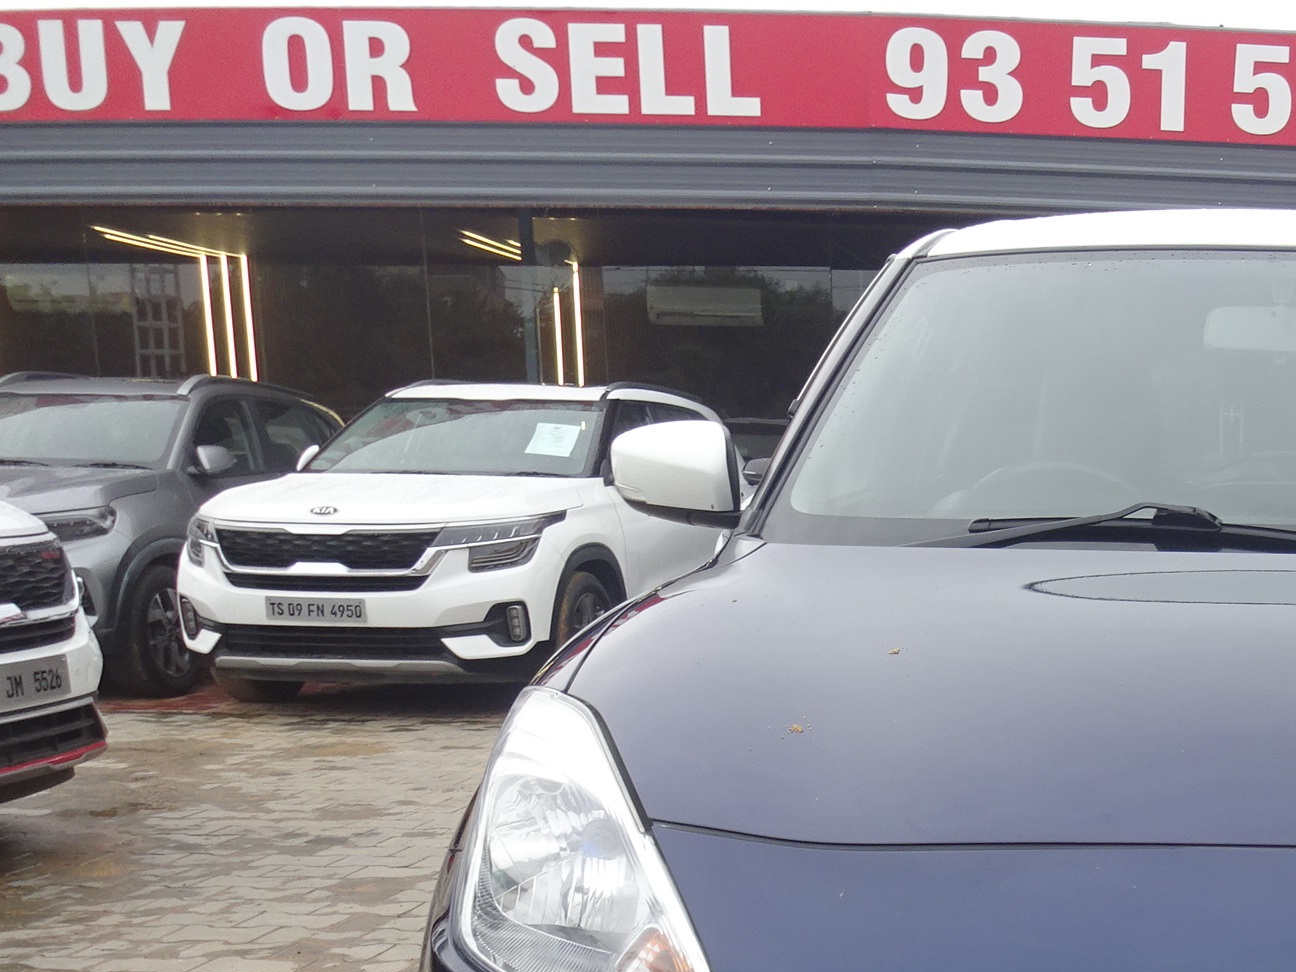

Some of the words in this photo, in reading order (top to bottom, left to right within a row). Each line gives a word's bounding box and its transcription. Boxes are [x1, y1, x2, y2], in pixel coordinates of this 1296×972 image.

[261, 15, 418, 112] OR
[494, 17, 762, 117] SELL
[885, 26, 1024, 123] 93
[1069, 36, 1187, 132] 51
[269, 602, 285, 616] TS
[287, 602, 303, 617] 09
[307, 603, 325, 618] FN
[330, 604, 362, 619] 4950
[6, 674, 25, 699] JM
[32, 668, 63, 693] 5526
